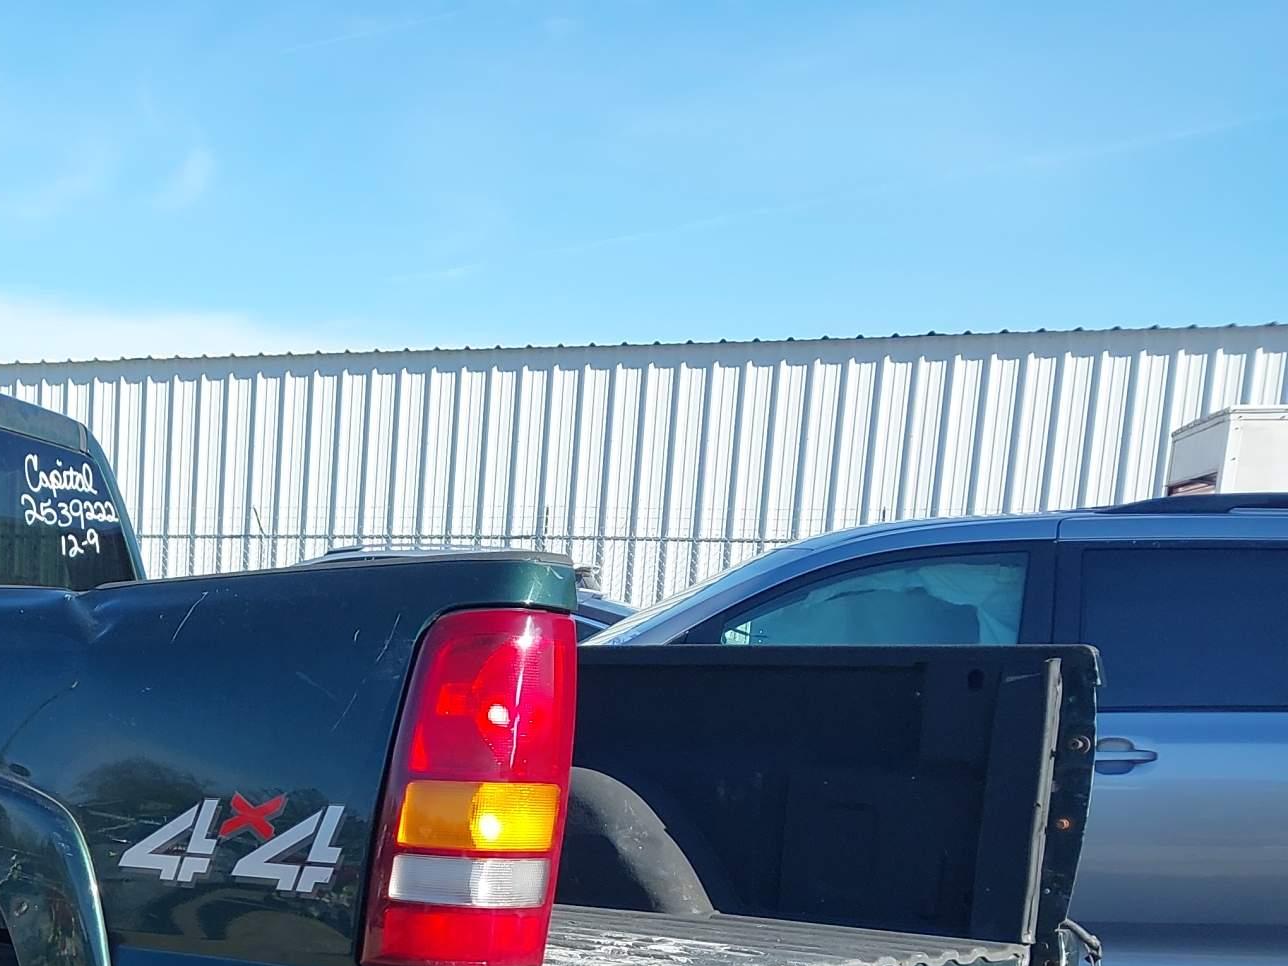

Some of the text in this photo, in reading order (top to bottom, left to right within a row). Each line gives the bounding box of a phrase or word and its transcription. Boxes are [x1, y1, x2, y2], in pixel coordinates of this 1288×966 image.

[25, 454, 98, 498] Capital
[20, 493, 120, 530] 2539222
[61, 528, 100, 558] 12-9
